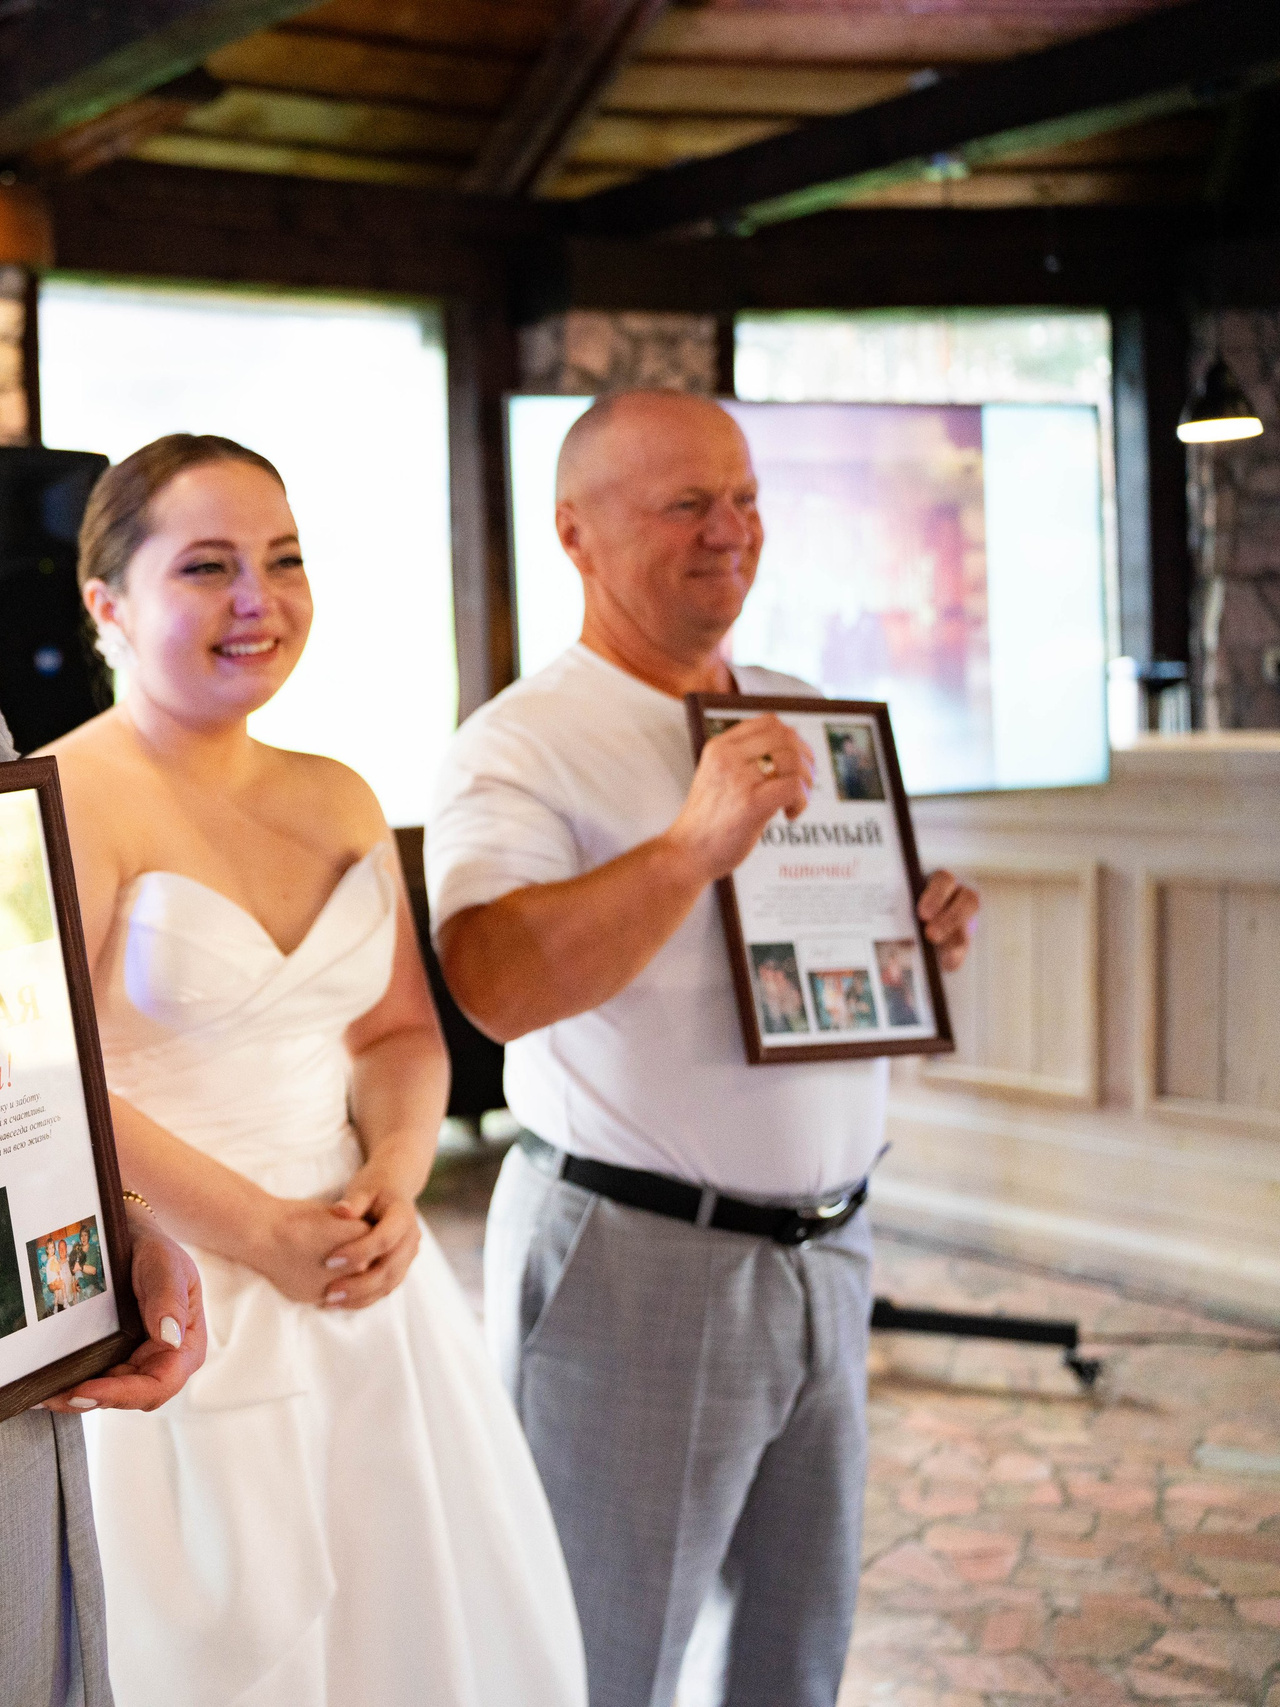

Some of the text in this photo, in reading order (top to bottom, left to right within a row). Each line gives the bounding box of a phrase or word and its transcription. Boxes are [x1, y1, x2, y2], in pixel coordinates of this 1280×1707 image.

[9, 1100, 14, 1109] и
[3, 1118, 8, 1126] я
[29, 1115, 61, 1131] останусь
[2, 1146, 12, 1155] на
[12, 1141, 27, 1152] всю
